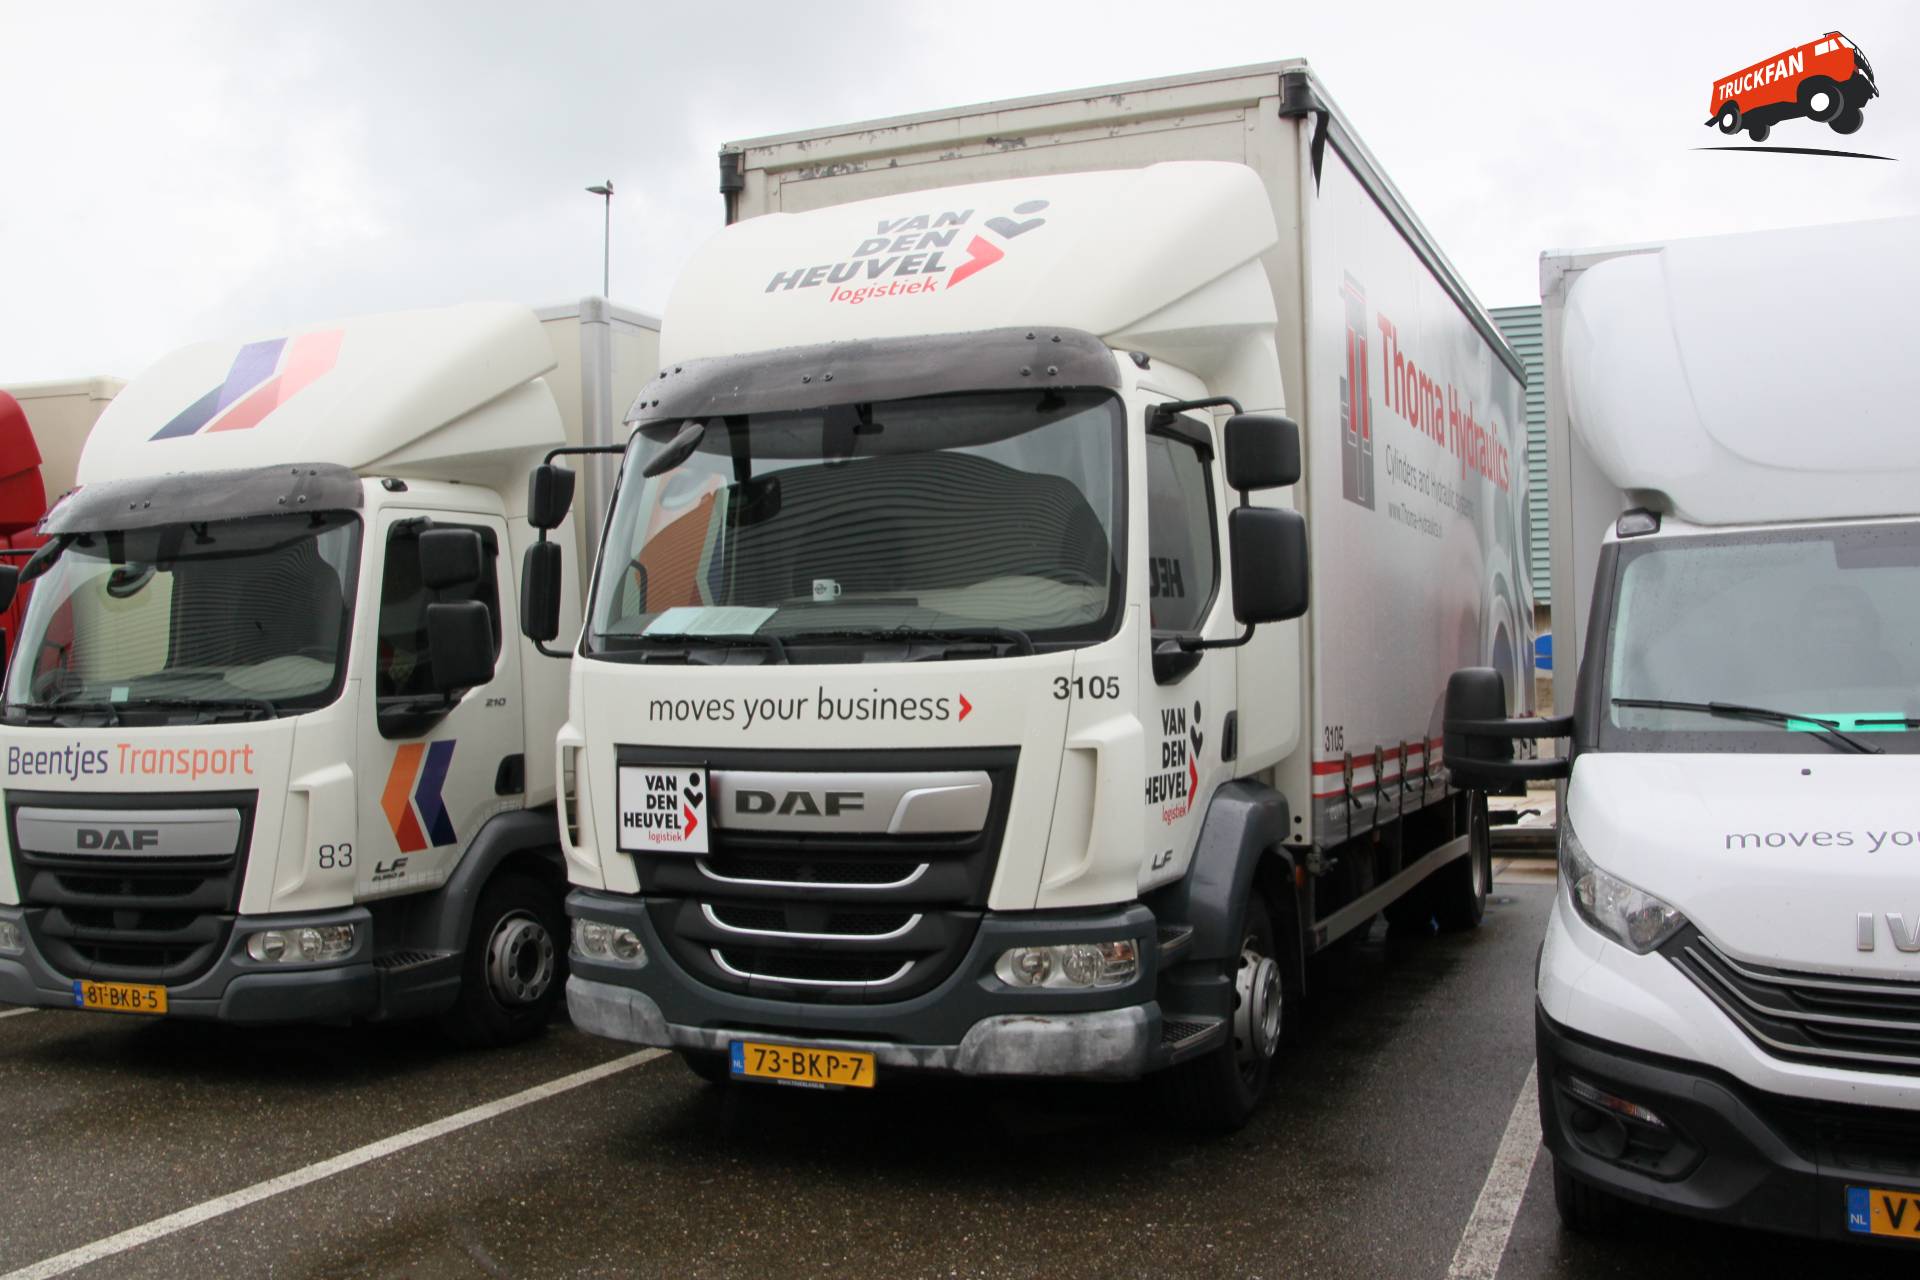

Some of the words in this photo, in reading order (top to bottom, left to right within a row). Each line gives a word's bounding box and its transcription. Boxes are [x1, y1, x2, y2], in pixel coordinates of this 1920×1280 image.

[877, 209, 975, 235] VAN
[852, 229, 960, 258] DEN
[764, 251, 947, 294] HEUVEL
[829, 276, 939, 304] logistiek
[1377, 312, 1445, 449] Thoma
[1448, 381, 1510, 494] Hydraulics
[1385, 443, 1417, 491] Cylinders
[1053, 676, 1121, 700] 3105
[648, 699, 735, 722] moves
[743, 696, 809, 730] your
[817, 687, 951, 720] business
[1161, 707, 1186, 736] VAN
[1325, 726, 1344, 751] 3105
[7, 742, 109, 781] Beentjes
[117, 744, 254, 780] Transport
[1162, 739, 1186, 769] DEN
[645, 775, 677, 791] VAN
[1145, 771, 1187, 805] HEUVEL
[646, 795, 677, 810] DEN
[735, 790, 864, 816] DAF
[1162, 804, 1188, 826] logistiek
[624, 812, 682, 830] HEUVEL
[77, 829, 159, 850] DAF
[648, 831, 682, 844] logistiek
[1726, 831, 1854, 850] moves
[1866, 831, 1920, 853] yo
[318, 843, 353, 869] 83
[374, 857, 409, 874] LF
[1151, 849, 1173, 871] LF
[754, 1048, 864, 1080] 73-BKP-7
[1850, 1213, 1867, 1225] NL
